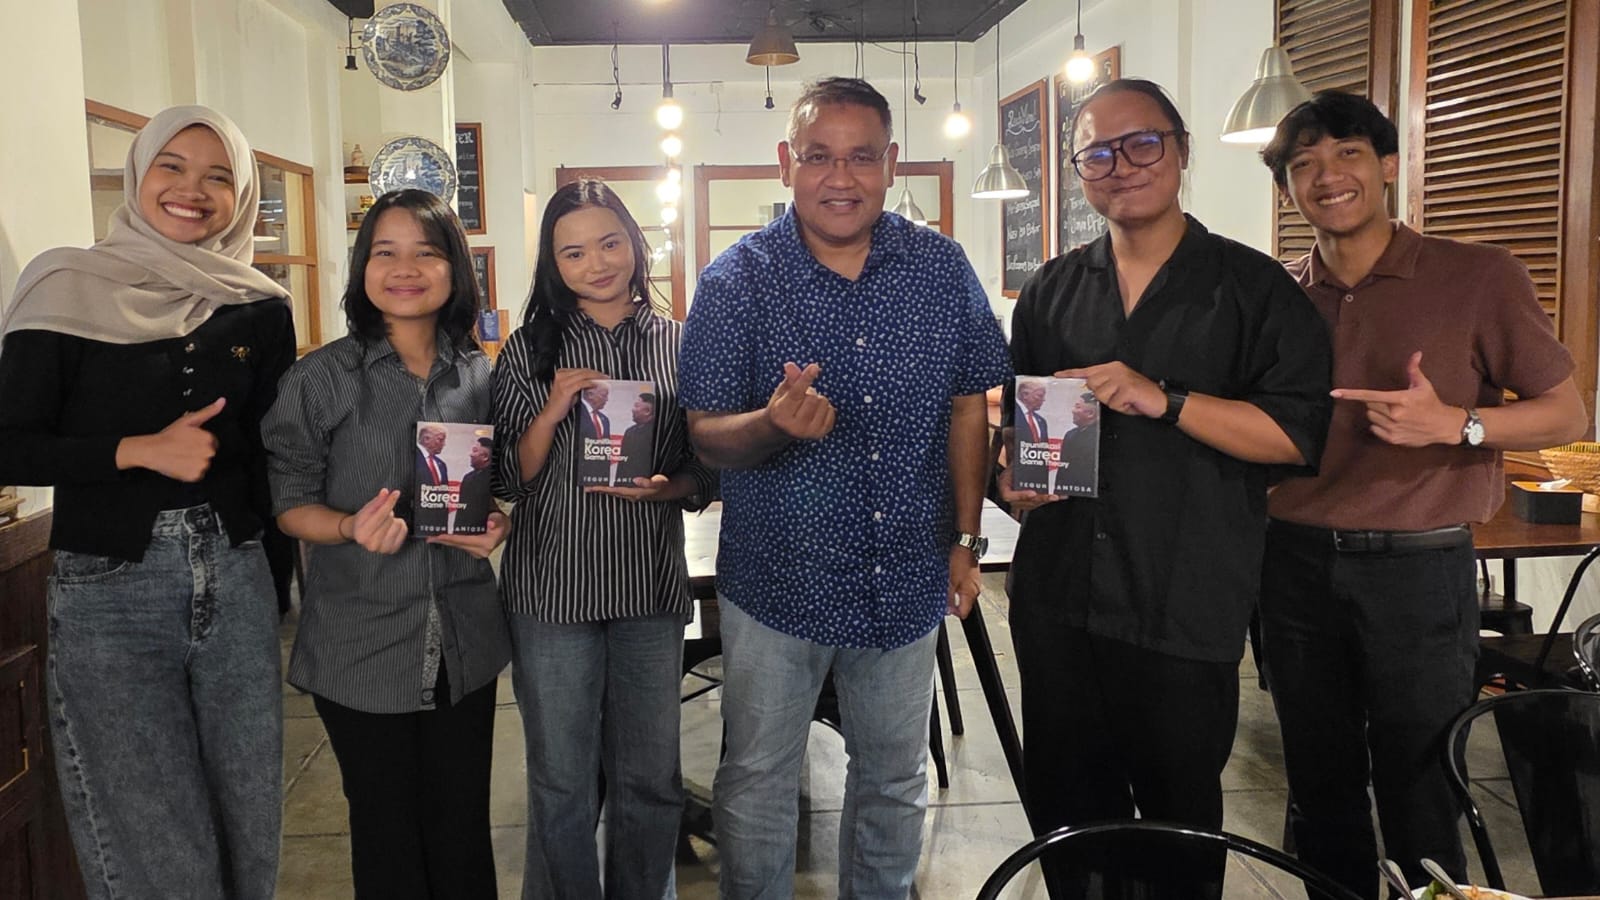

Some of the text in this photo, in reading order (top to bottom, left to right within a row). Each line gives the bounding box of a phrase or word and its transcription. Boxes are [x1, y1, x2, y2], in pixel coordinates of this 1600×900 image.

[584, 443, 621, 456] Korea
[1020, 447, 1061, 461] Korea
[1045, 461, 1069, 469] Theory
[1056, 485, 1092, 493] ANTOSA
[421, 489, 460, 503] Korea
